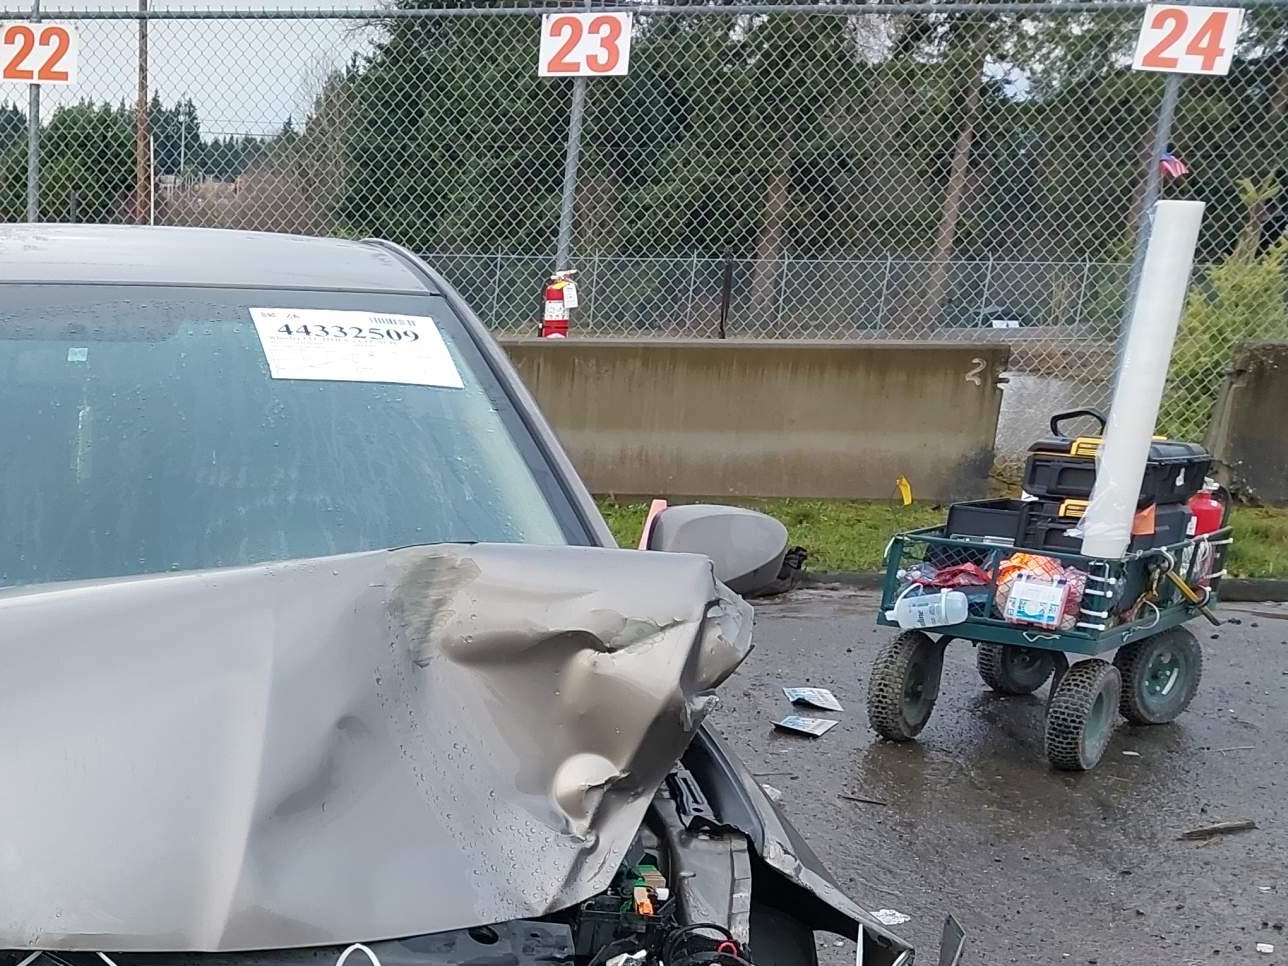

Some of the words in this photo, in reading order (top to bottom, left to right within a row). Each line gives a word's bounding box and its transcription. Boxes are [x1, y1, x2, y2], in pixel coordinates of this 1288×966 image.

[2, 25, 70, 81] 22
[546, 15, 622, 74] 23
[1142, 9, 1228, 71] 24
[277, 323, 421, 343] 44332509
